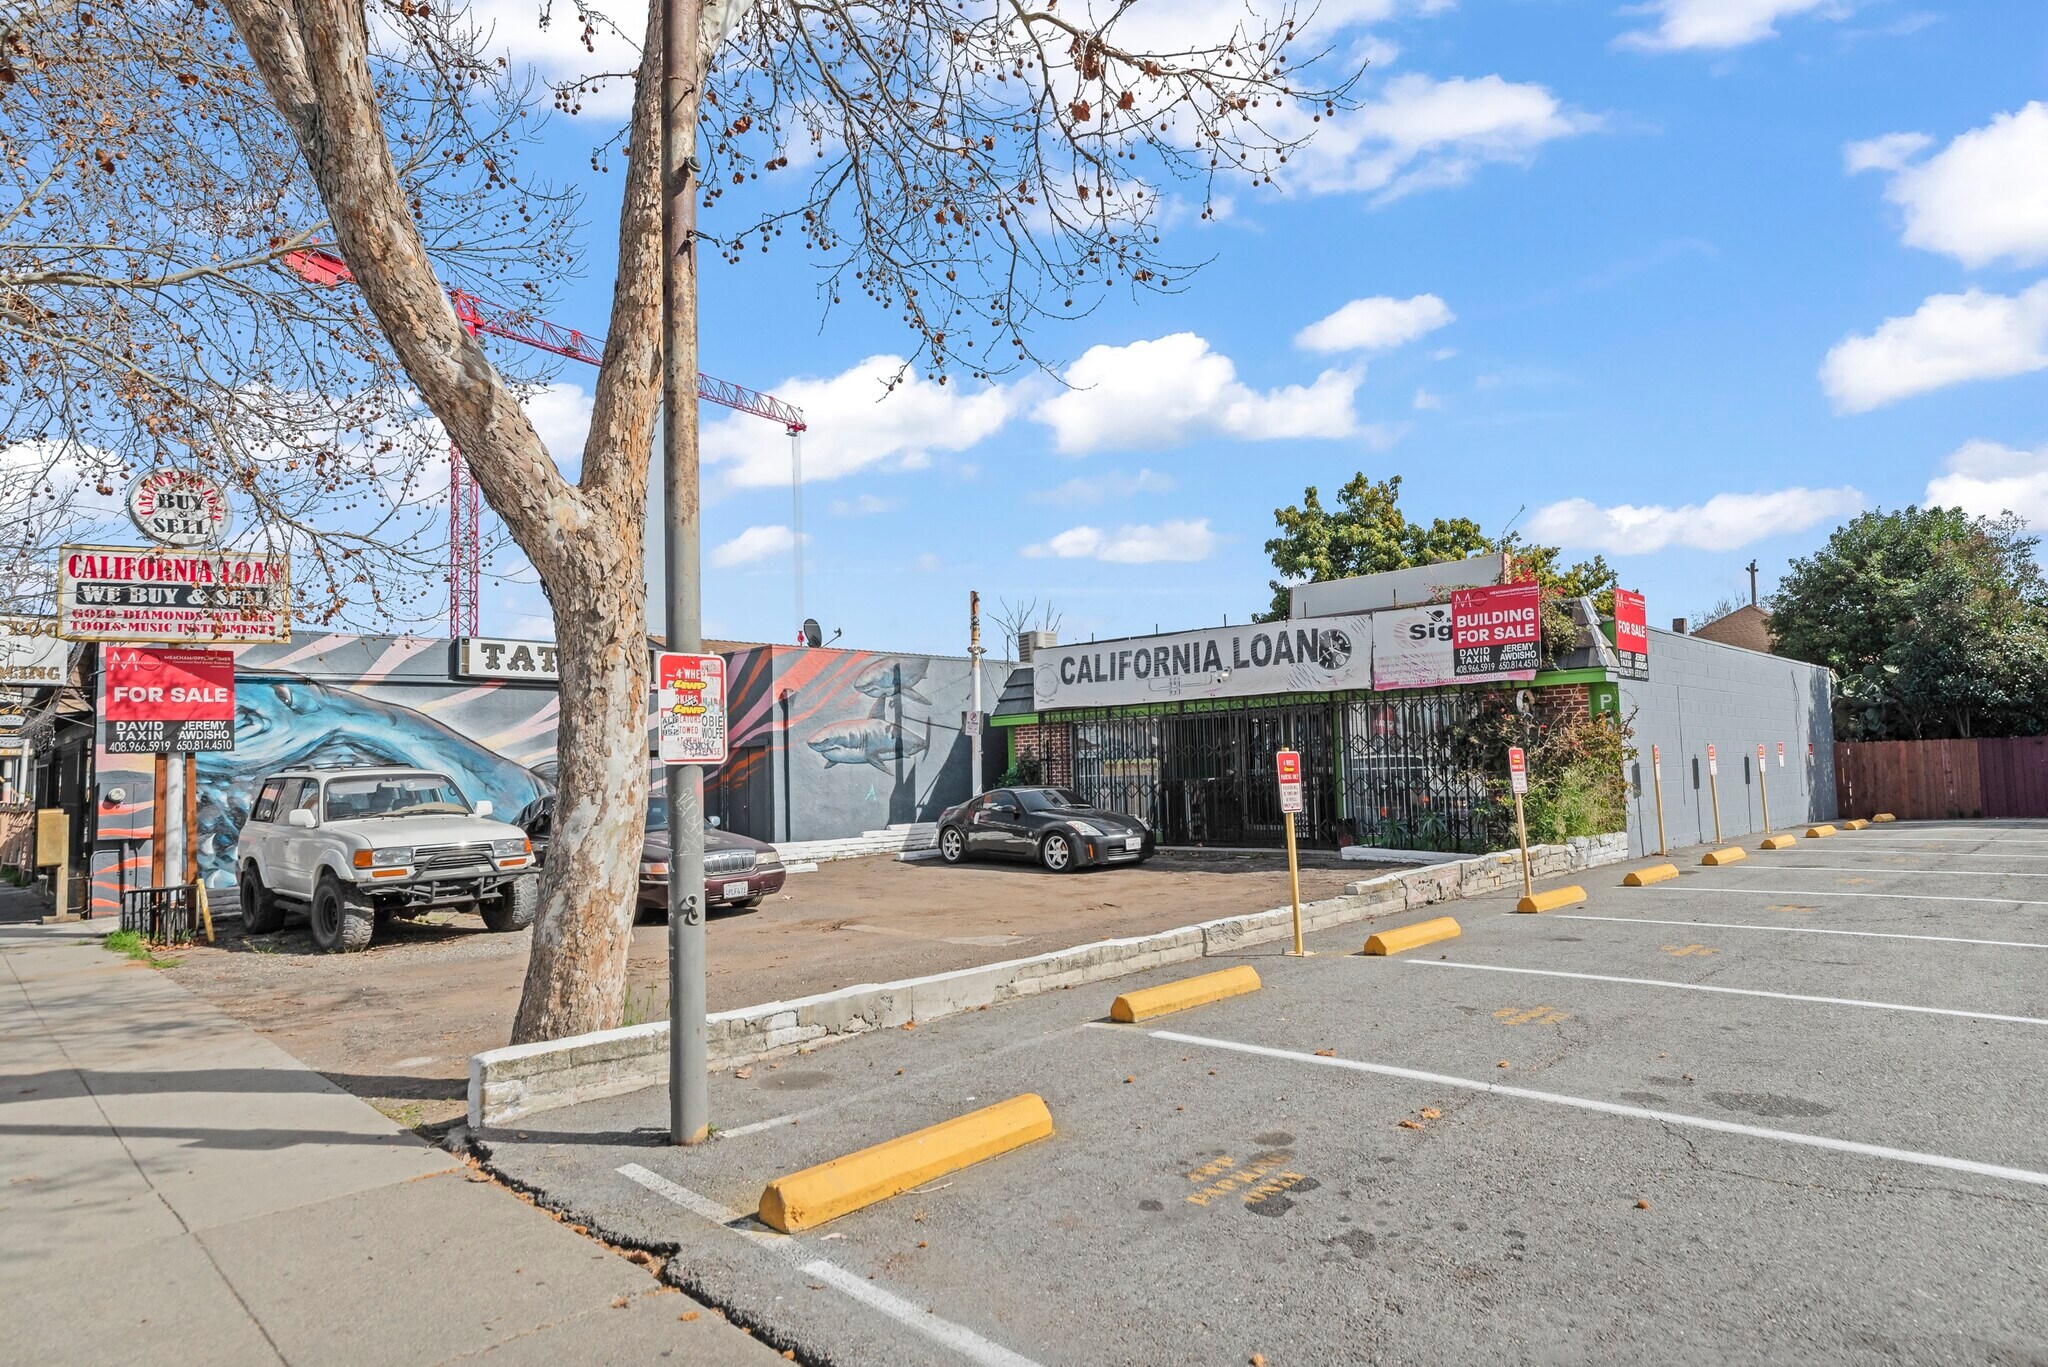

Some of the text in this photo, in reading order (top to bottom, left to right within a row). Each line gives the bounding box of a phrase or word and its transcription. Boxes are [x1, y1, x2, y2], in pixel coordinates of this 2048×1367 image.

[157, 494, 204, 511] BUY
[153, 518, 208, 535] SELL
[68, 555, 282, 585] CALIFORNIA LOAN
[81, 585, 121, 603] WE
[129, 587, 179, 604] BUY
[186, 588, 206, 605] &
[1456, 608, 1535, 628] BUILDING
[177, 623, 276, 635] INSTUMENTS
[1458, 624, 1535, 643] FOR SALE
[1618, 621, 1646, 638] FOR SALE
[1460, 647, 1490, 657] DAVID
[1502, 643, 1534, 653] JEREMY
[1060, 628, 1318, 686] CALIFORNIA LOAN
[1460, 655, 1490, 665] TAXIN
[1500, 651, 1537, 661] AWDISHO
[1456, 663, 1495, 674] 408.966.5919
[1499, 659, 1539, 670] 650.814.4510
[684, 668, 700, 679] WHE
[114, 687, 228, 703] FOR SALE
[116, 721, 164, 731] DAVID
[182, 721, 226, 730] JEREMY
[702, 715, 723, 727] OBIE
[178, 730, 230, 740] AWDISHO
[679, 726, 699, 734] TOWED
[702, 727, 723, 739] WOLFE
[116, 731, 163, 741] TAXIN
[108, 741, 171, 752] 408.966.5919
[176, 740, 232, 751] 650.814.4510
